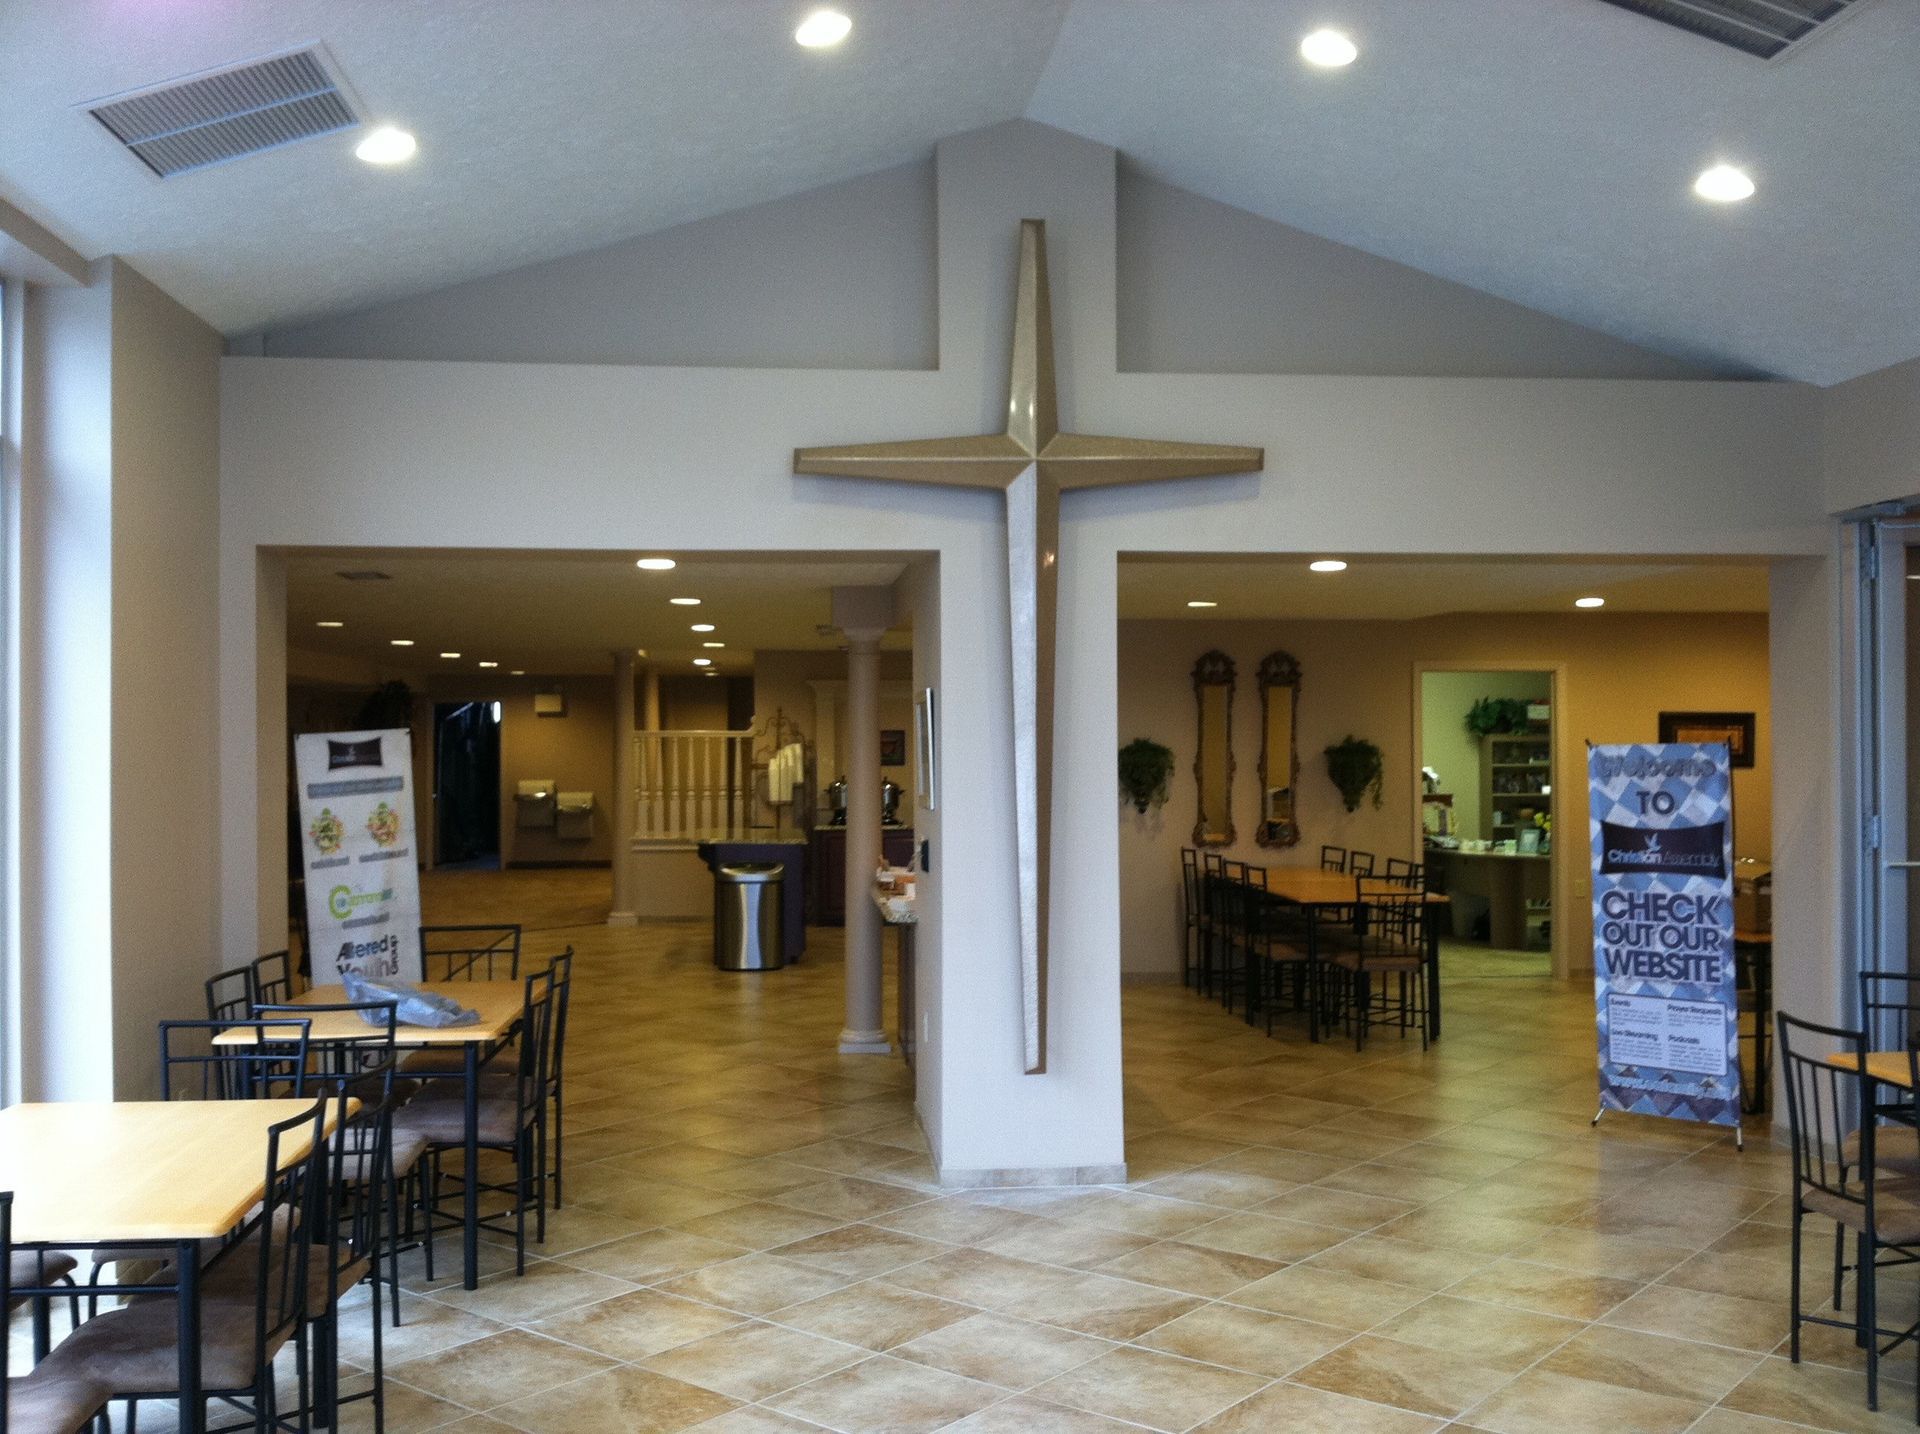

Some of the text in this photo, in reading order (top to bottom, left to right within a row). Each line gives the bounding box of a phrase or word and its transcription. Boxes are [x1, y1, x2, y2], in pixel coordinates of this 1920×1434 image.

[1635, 790, 1675, 816] TO
[1608, 849, 1662, 865] Christian
[1602, 890, 1722, 925] CHECK
[1603, 921, 1720, 951] OUT OUR
[1604, 949, 1721, 983] WEBSITE
